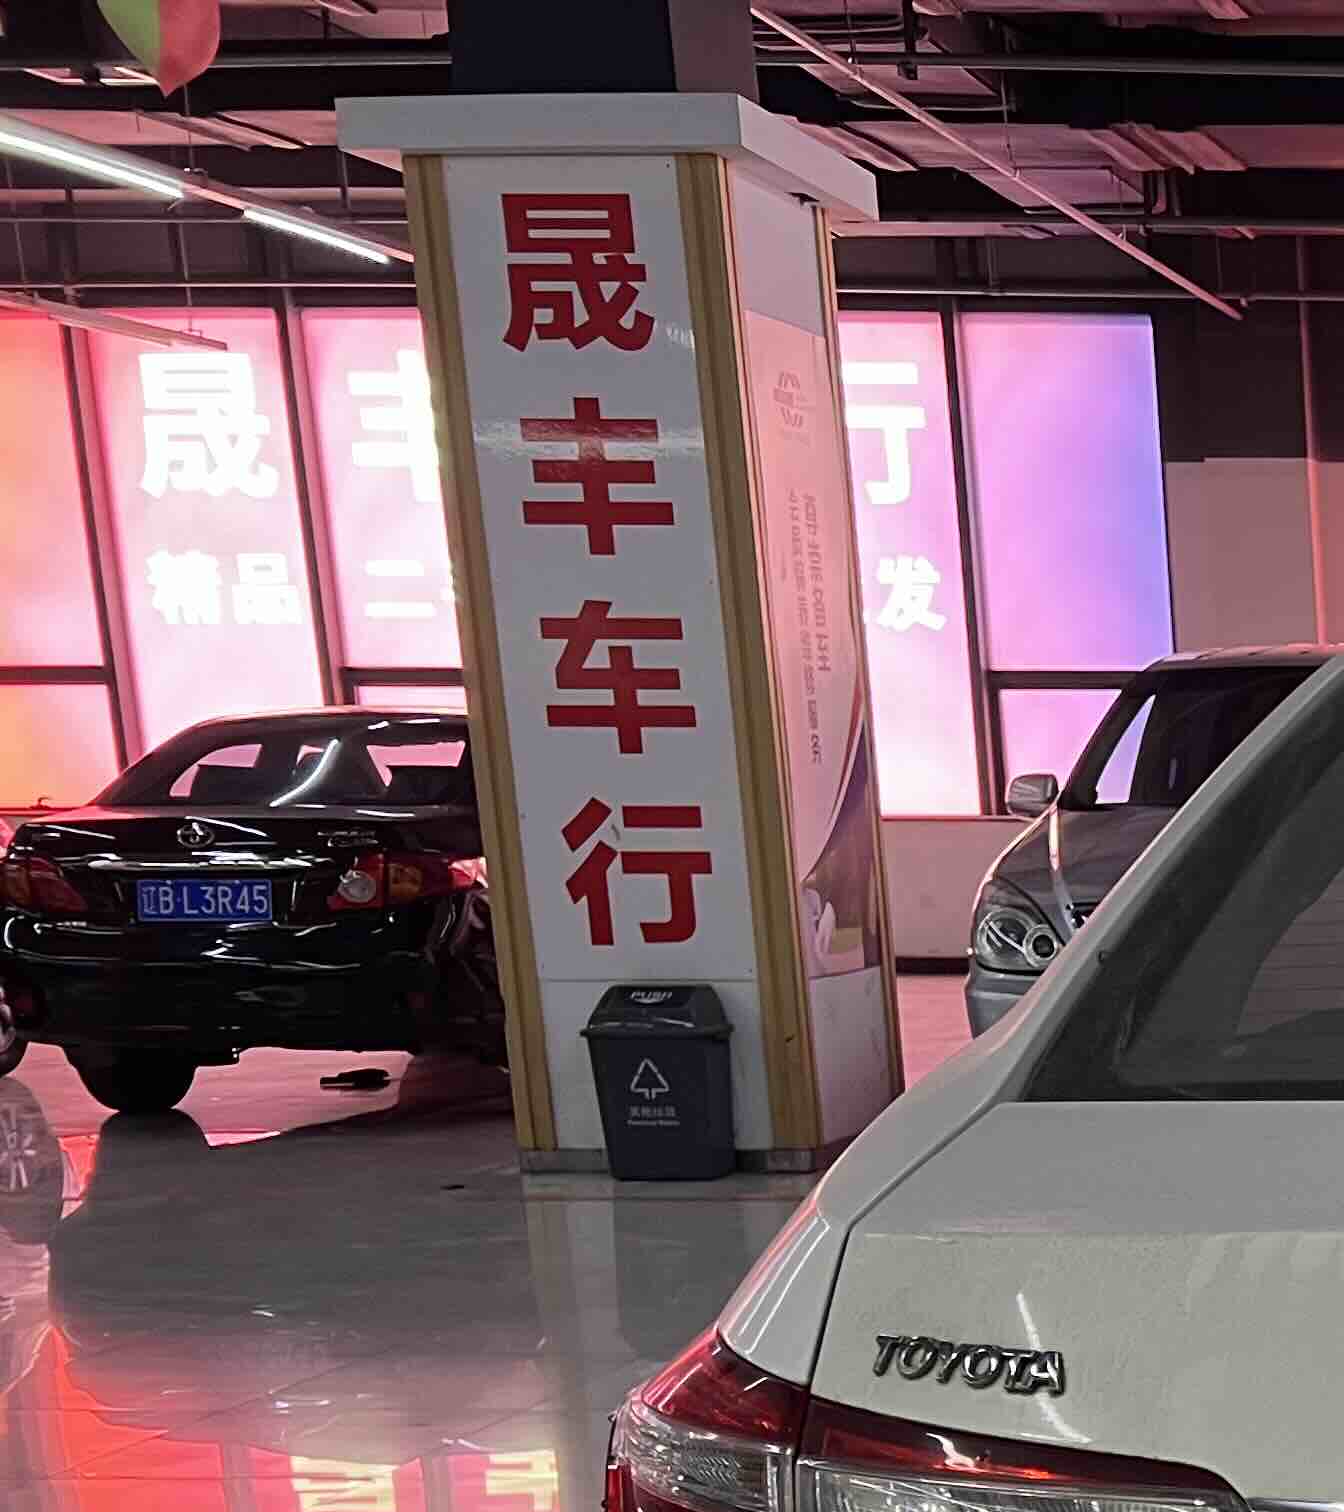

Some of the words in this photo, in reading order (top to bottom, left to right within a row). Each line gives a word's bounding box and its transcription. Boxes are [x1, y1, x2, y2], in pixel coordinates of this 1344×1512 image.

[501, 193, 712, 946] 晟丰车行
[873, 1335, 1066, 1398] TOYOTA
